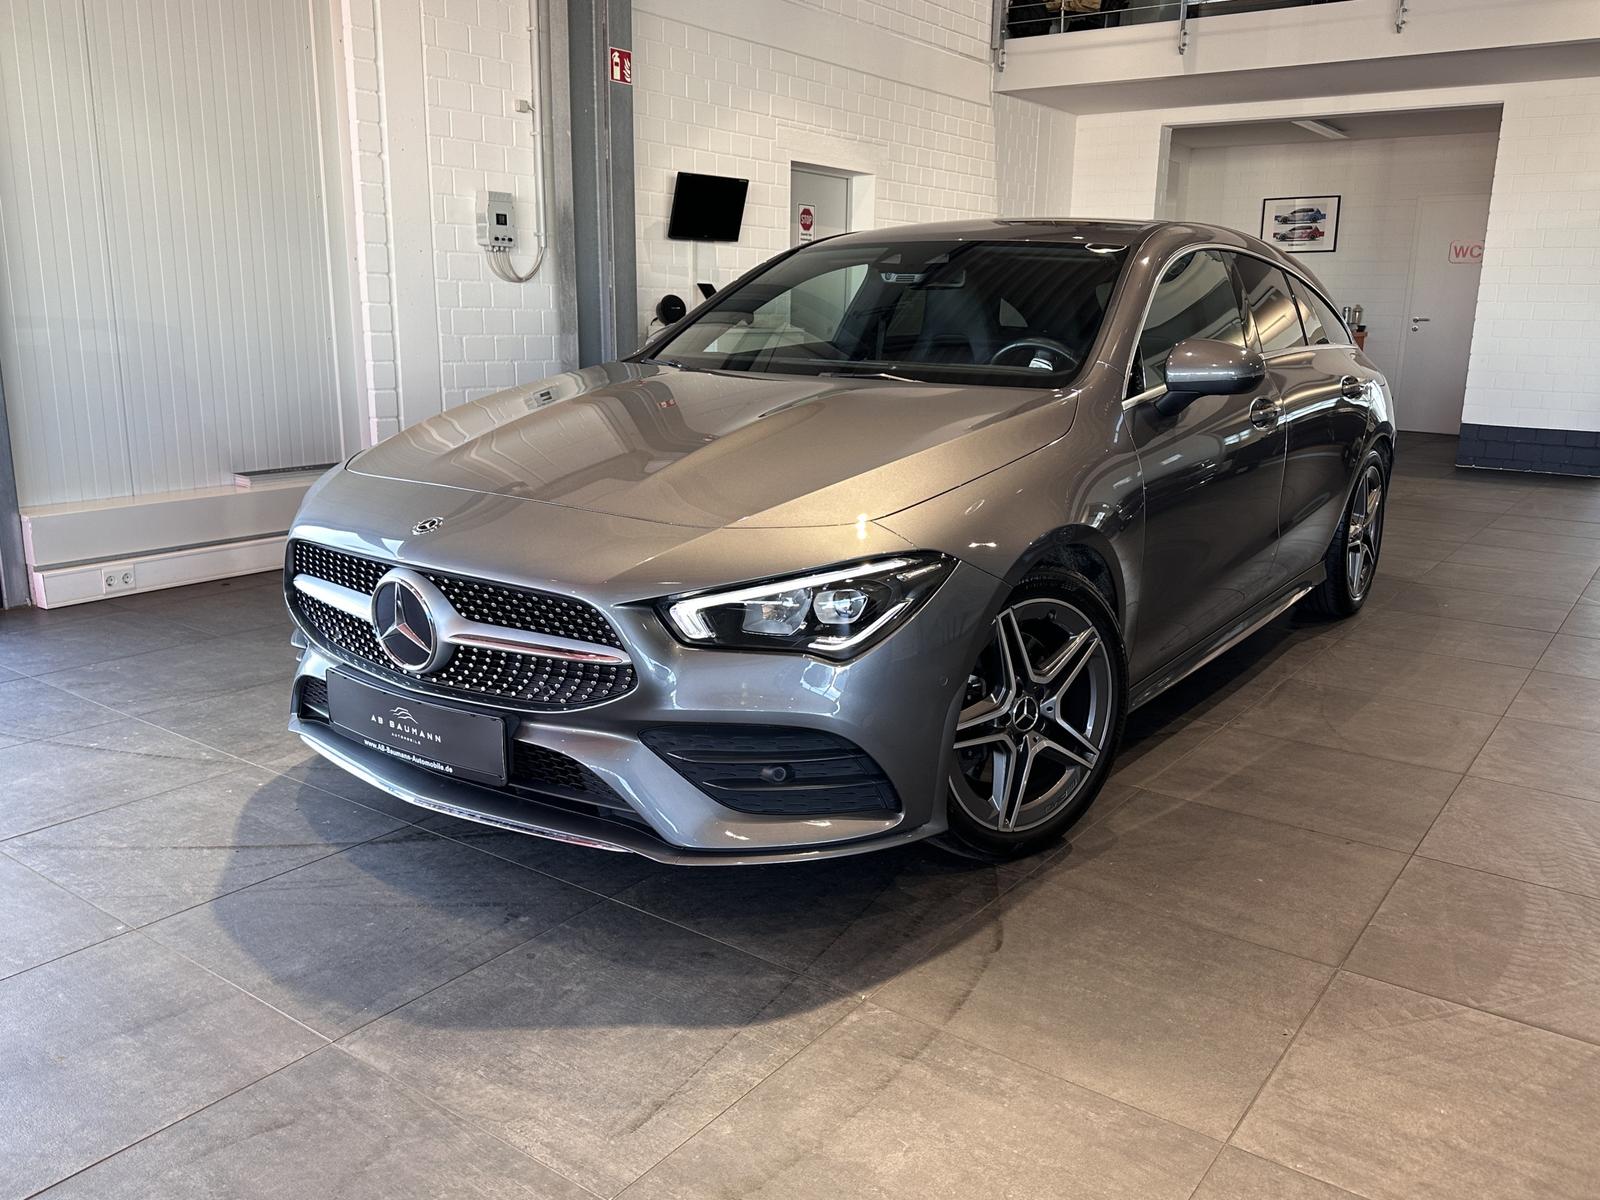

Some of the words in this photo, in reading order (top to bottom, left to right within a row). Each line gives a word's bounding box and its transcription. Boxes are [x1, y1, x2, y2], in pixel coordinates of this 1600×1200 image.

[801, 214, 813, 225] STOP
[1454, 245, 1482, 258] WC
[371, 714, 384, 725] AB
[389, 720, 442, 743] BAUMANN
[363, 739, 453, 774] www.AB-Baumann-Automobile.de
